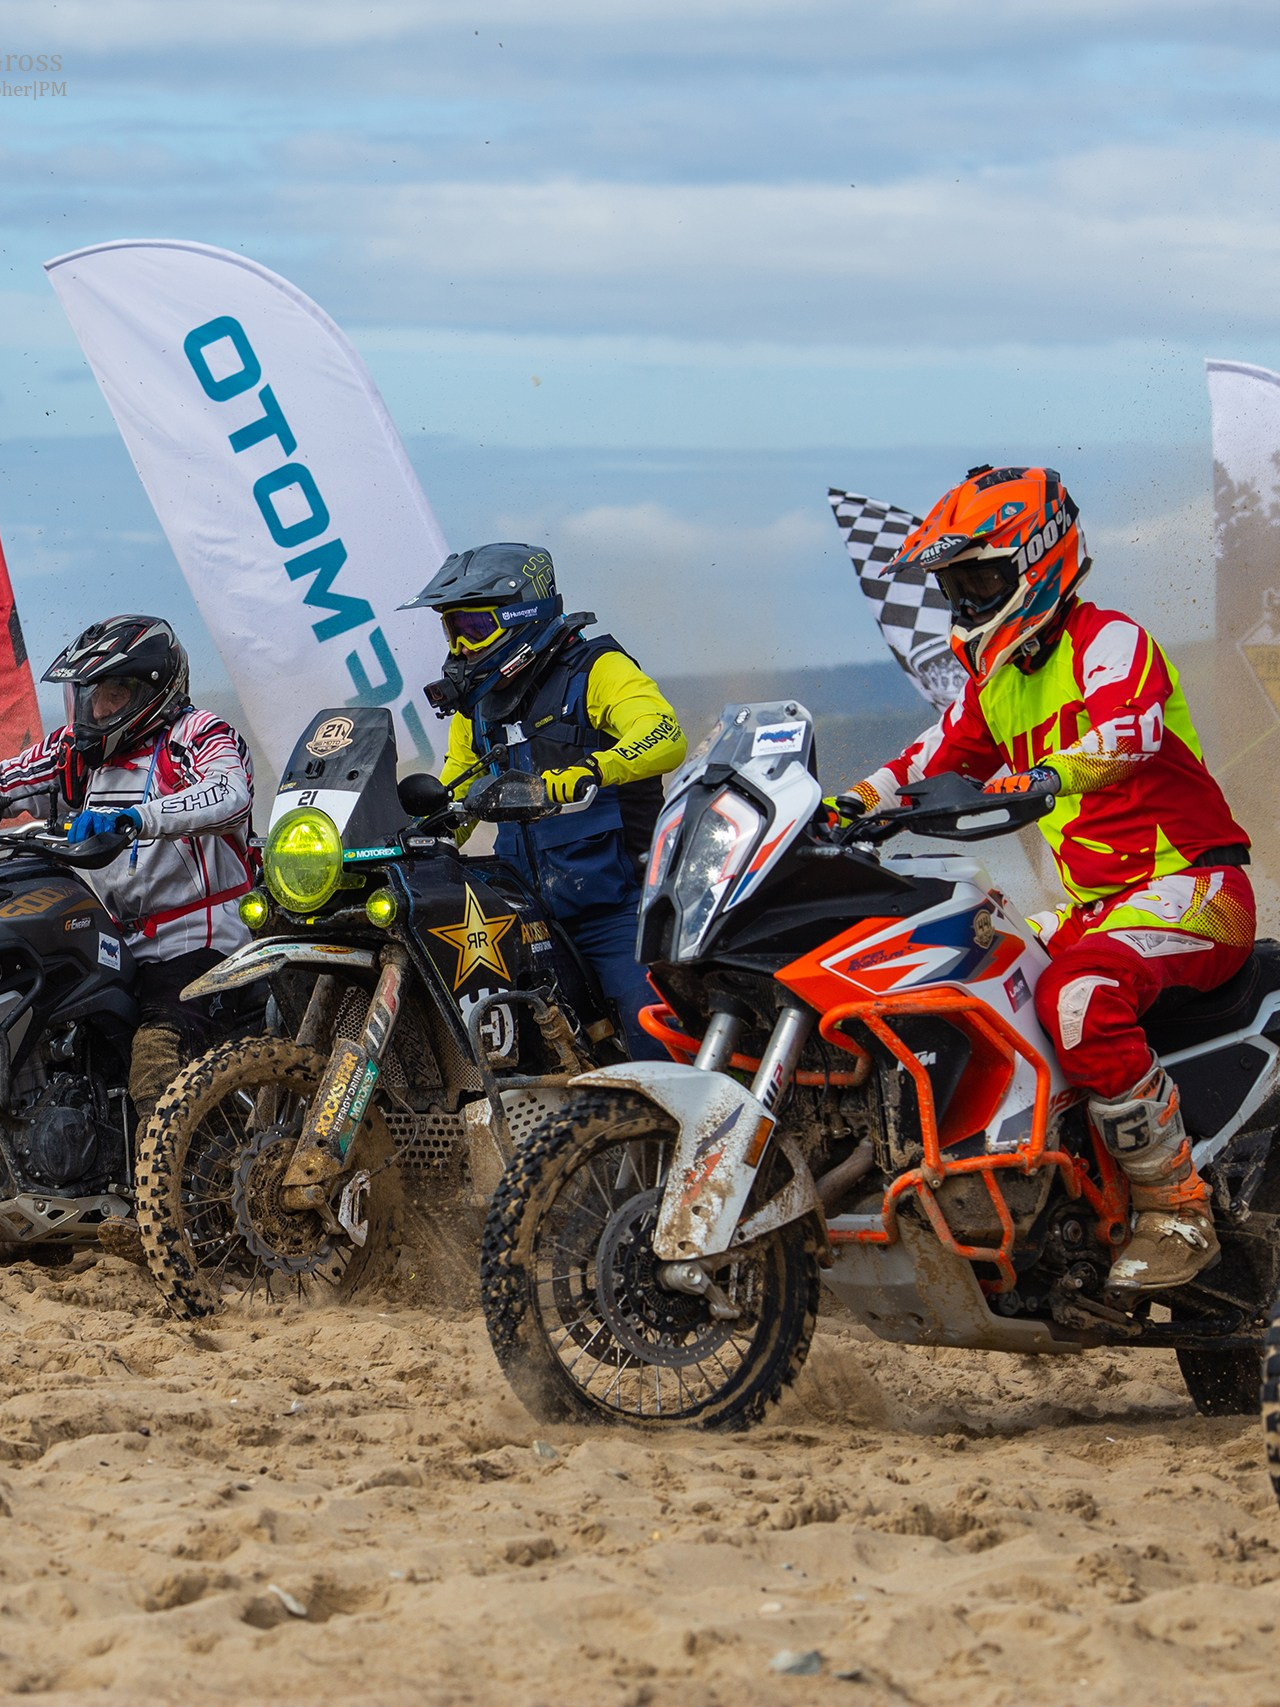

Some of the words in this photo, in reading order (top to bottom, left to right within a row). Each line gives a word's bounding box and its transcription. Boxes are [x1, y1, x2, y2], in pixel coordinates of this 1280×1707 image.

[1011, 508, 1071, 571] 100%
[322, 723, 342, 738] 21
[297, 790, 319, 807] 21
[356, 848, 396, 859] MOTOREX
[977, 917, 991, 931] 44
[348, 1066, 365, 1097] DRINK
